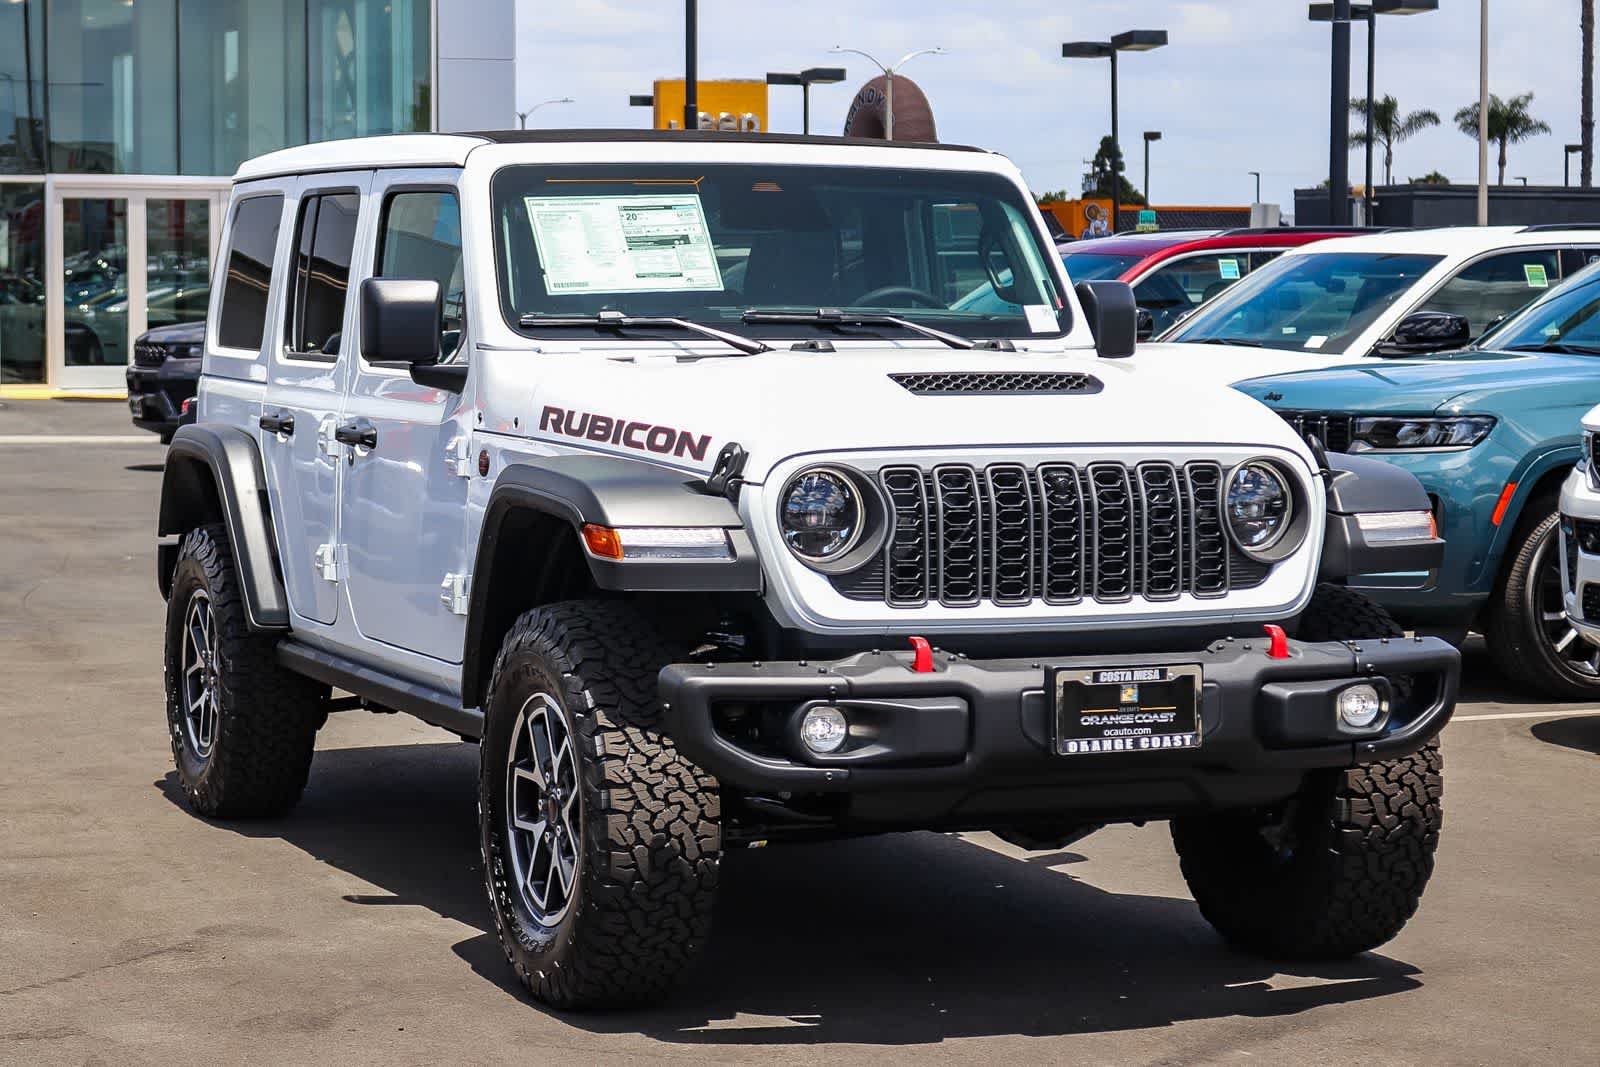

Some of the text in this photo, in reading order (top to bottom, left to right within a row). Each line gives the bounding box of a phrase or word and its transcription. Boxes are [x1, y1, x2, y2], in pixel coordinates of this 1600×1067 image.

[539, 405, 712, 462] RUBICON
[1099, 669, 1161, 683] COSTA MESA
[1080, 712, 1176, 726] ORANGE COAST
[1103, 727, 1152, 736] ocauto.com
[1067, 735, 1193, 753] ORANGE COAST
